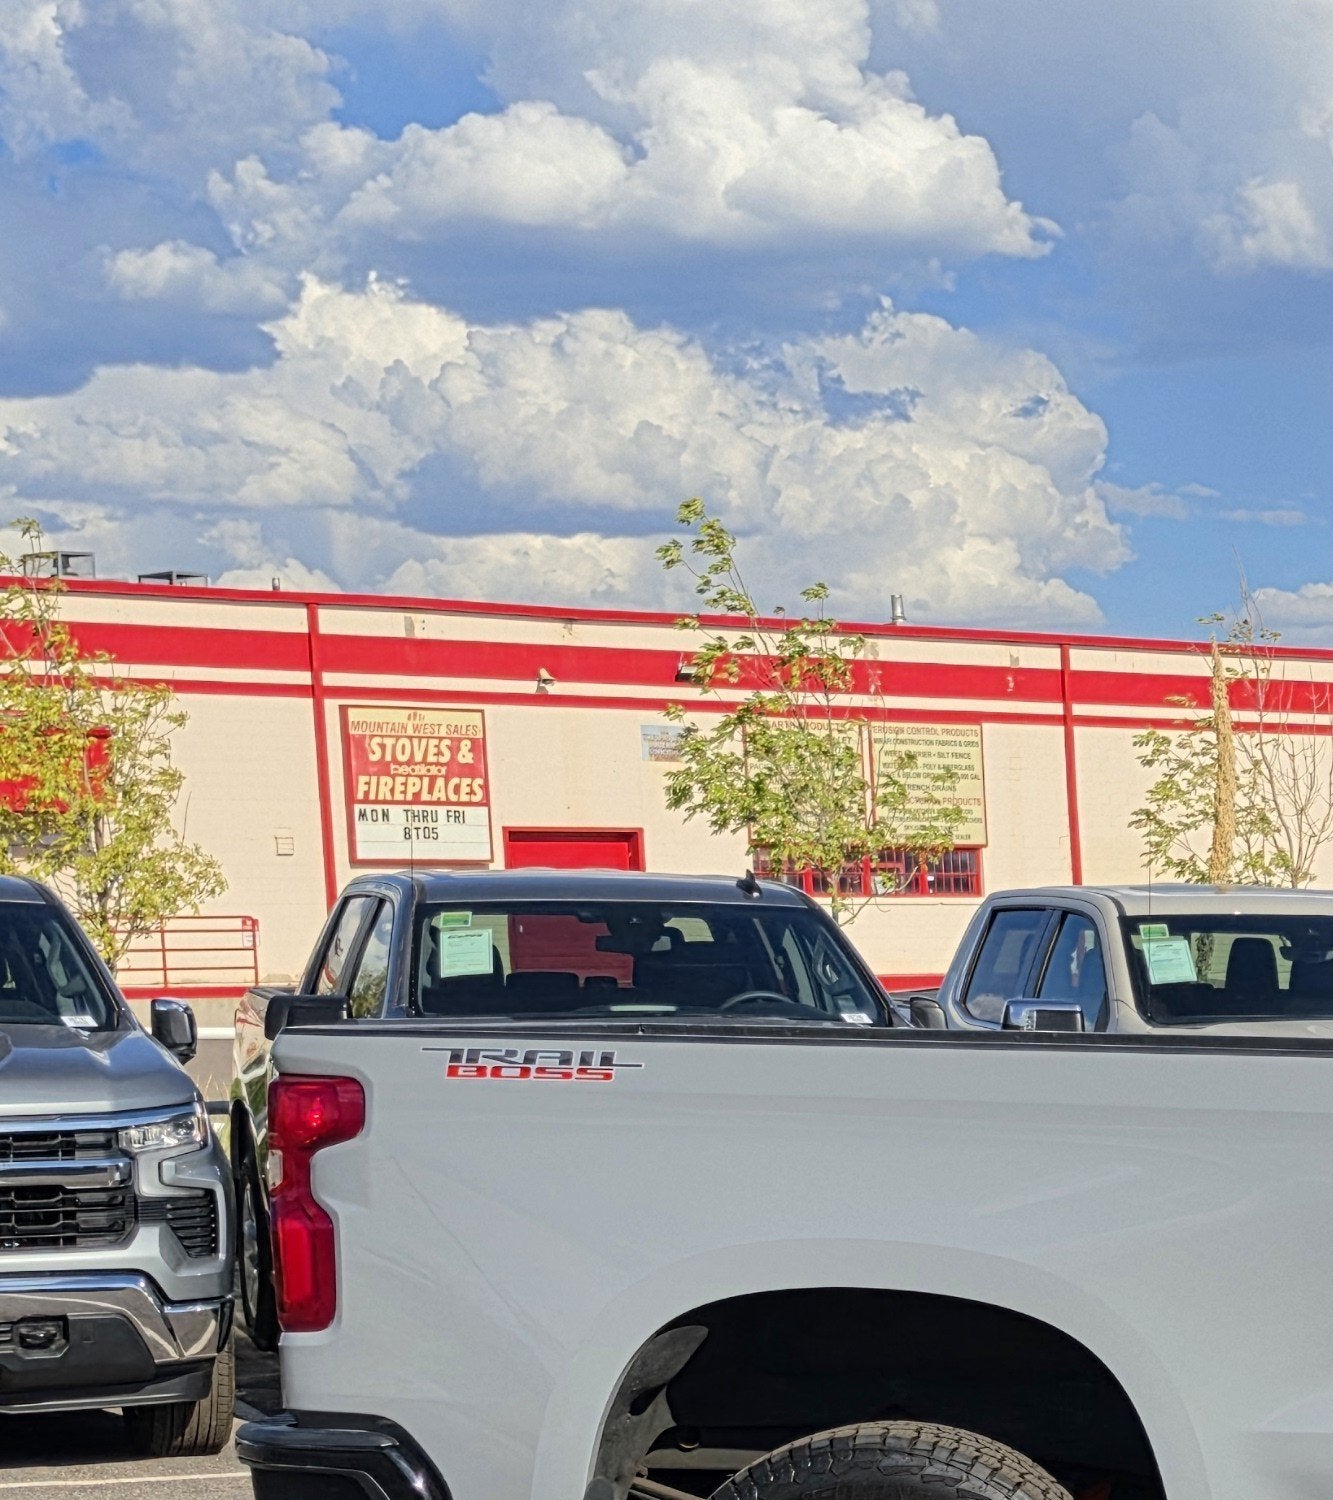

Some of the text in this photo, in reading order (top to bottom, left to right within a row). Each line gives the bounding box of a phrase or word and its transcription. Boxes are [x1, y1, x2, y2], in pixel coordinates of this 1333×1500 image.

[350, 720, 478, 736] MOUNTAIN WEST SALES
[906, 727, 940, 736] CONTROL
[941, 728, 978, 738] PRODUCTS
[368, 736, 474, 764] STOVES &
[356, 775, 484, 803] FIREPLACES
[358, 808, 466, 824] MON THRU FRI
[422, 1047, 644, 1070] TRAIL
[446, 1065, 615, 1083] BOSS
